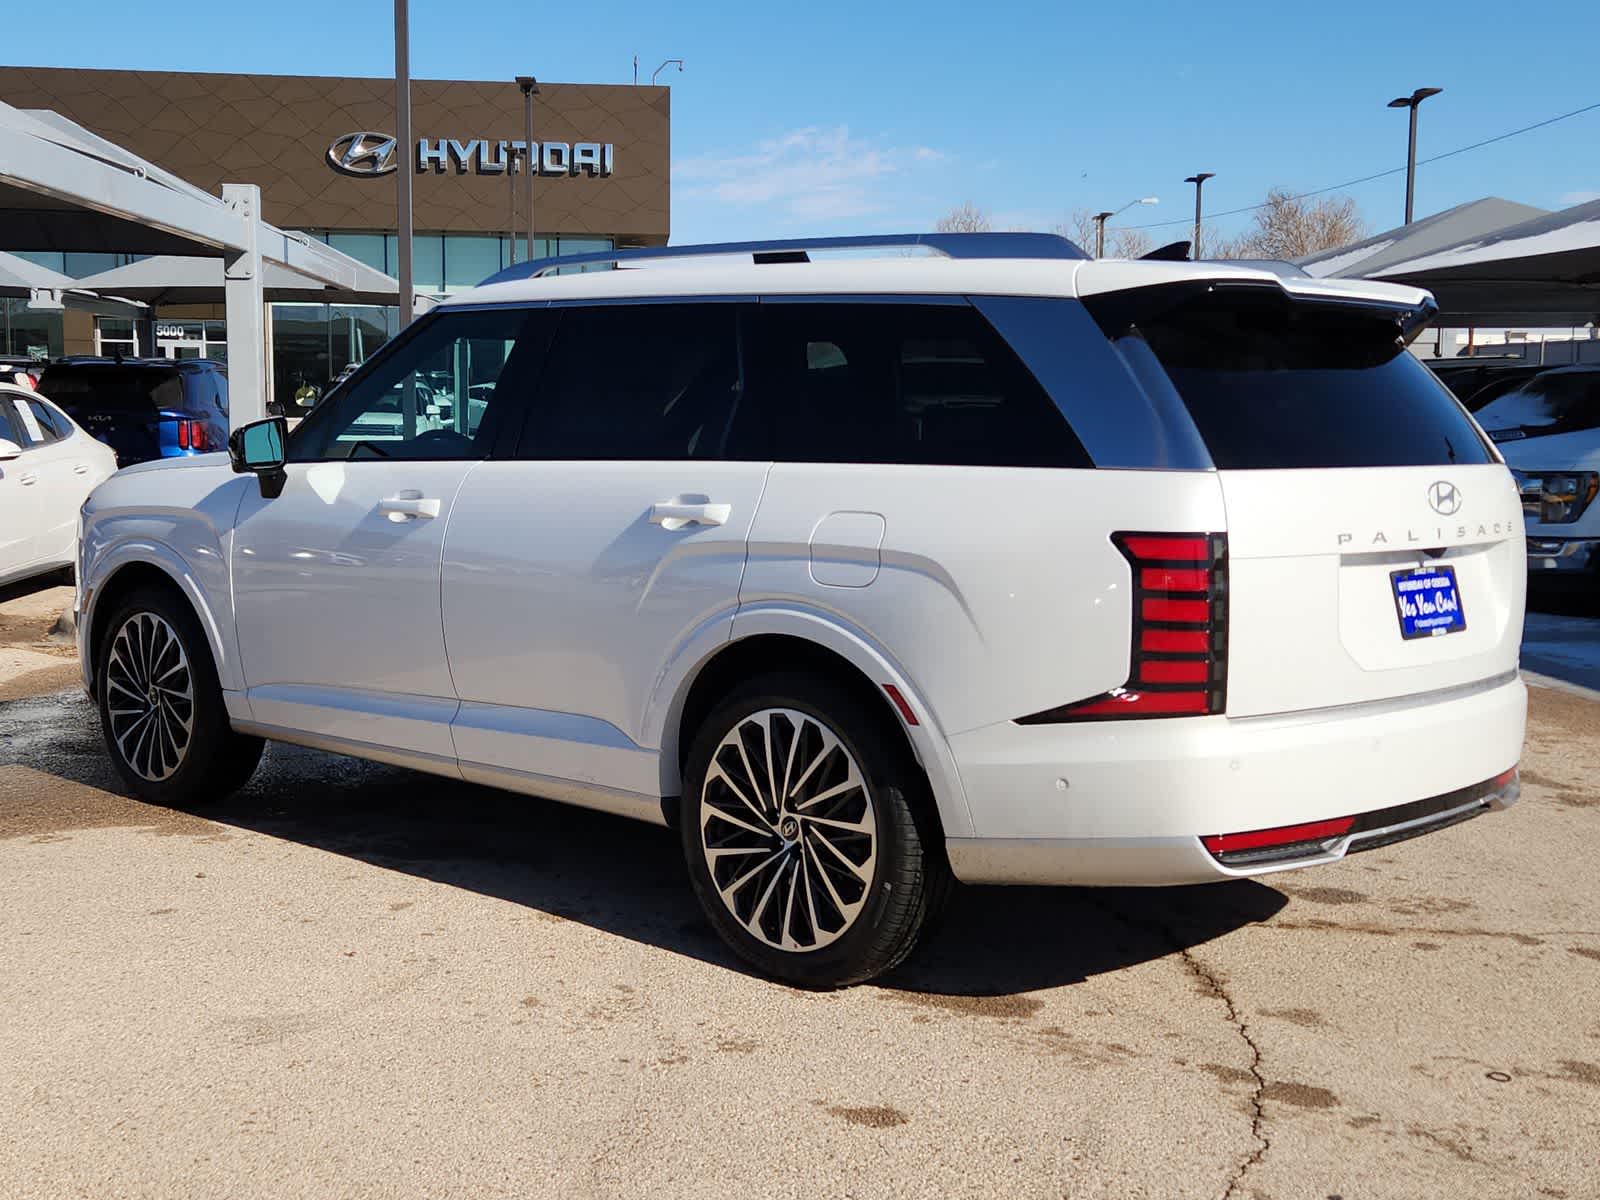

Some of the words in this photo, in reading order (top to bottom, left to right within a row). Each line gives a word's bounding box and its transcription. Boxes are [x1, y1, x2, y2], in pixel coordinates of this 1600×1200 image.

[417, 137, 614, 176] HYUNDAI
[156, 325, 184, 337] 5000
[1337, 521, 1513, 546] PALISADE
